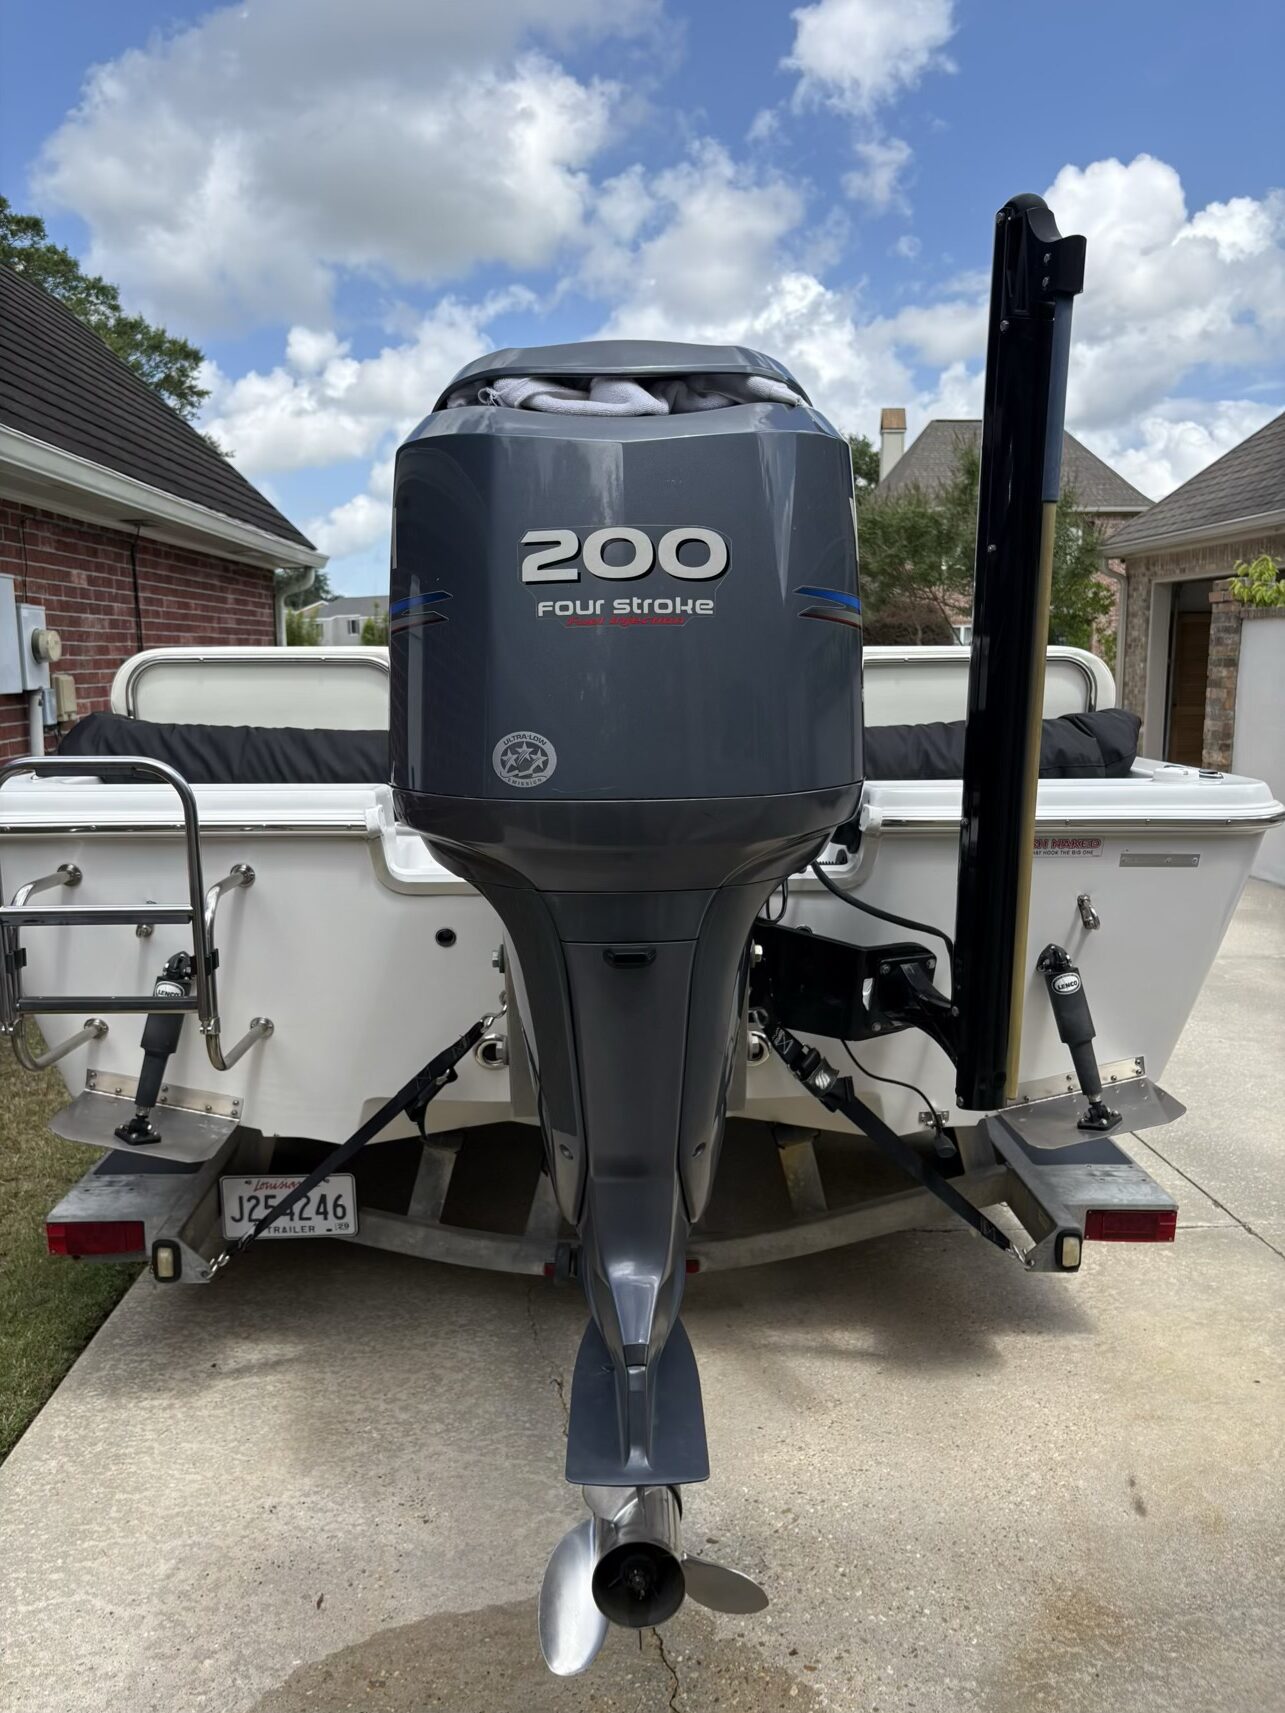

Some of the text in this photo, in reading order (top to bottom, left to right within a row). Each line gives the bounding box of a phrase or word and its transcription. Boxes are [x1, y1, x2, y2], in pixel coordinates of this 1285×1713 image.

[520, 527, 730, 583] 200
[1057, 980, 1078, 990] LENCO
[267, 1225, 315, 1234] TRAILER
